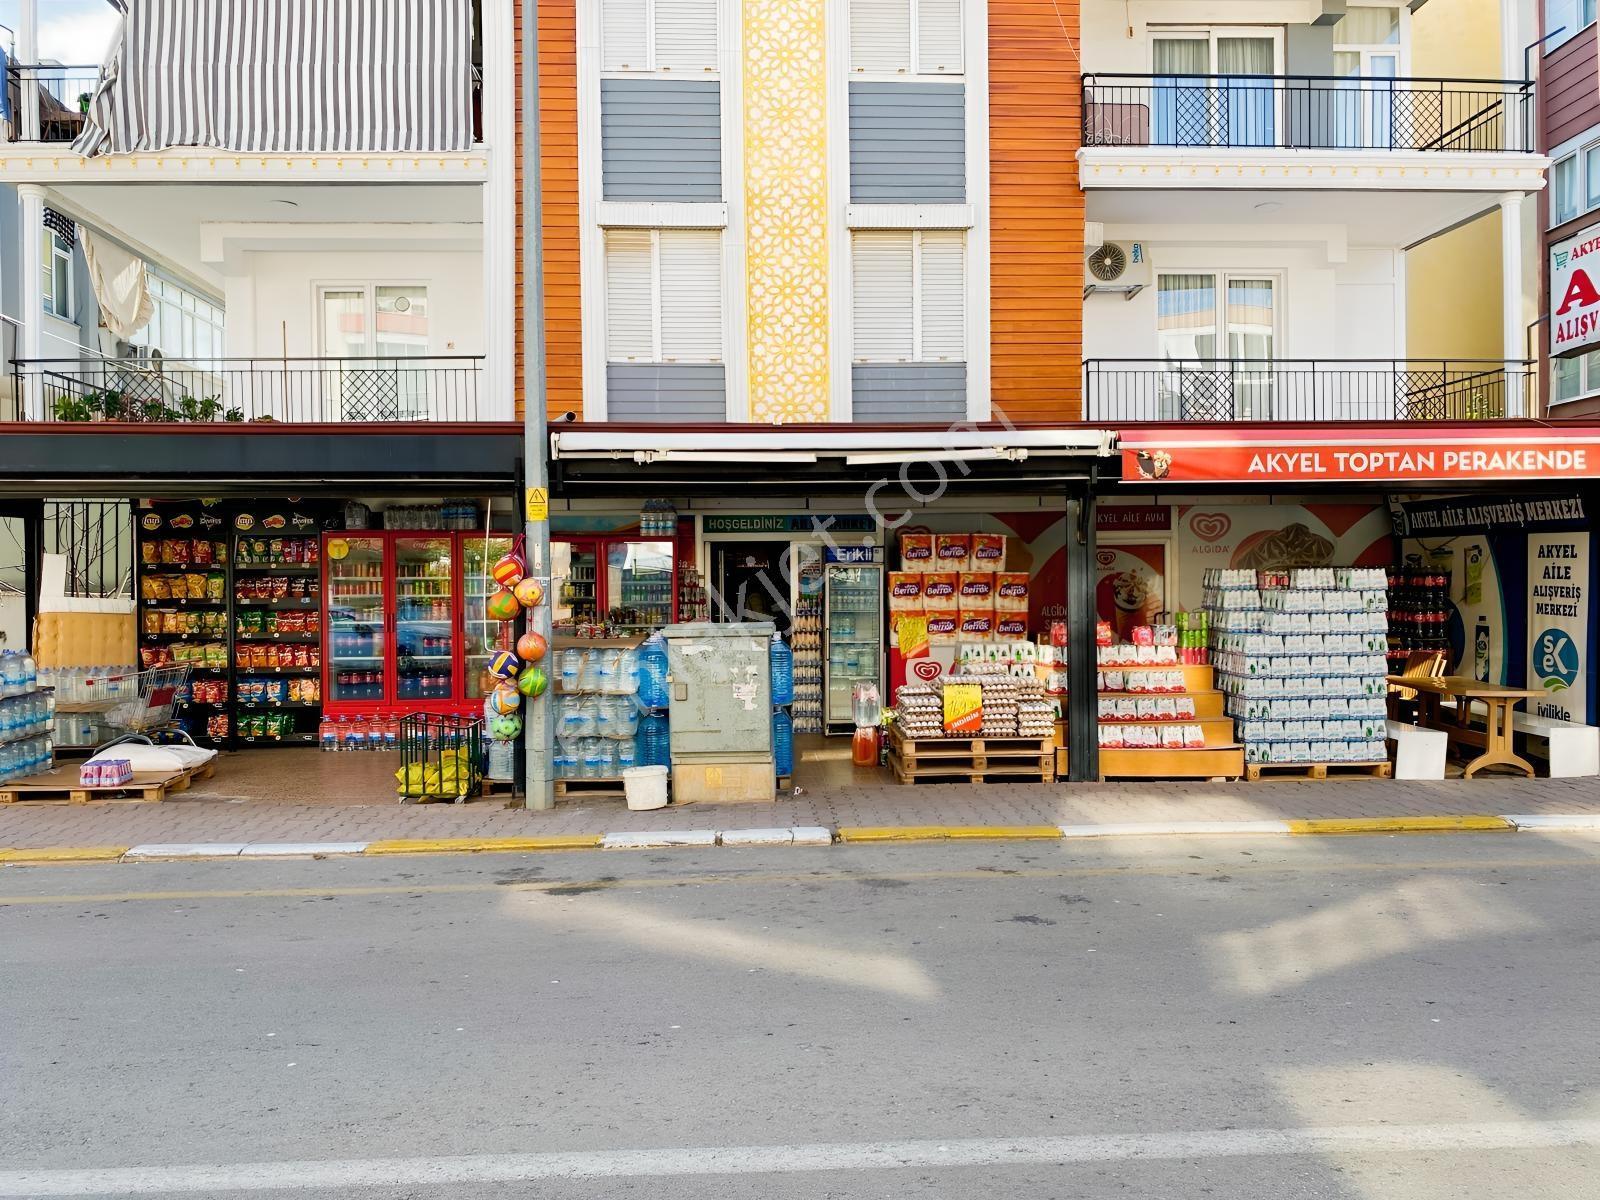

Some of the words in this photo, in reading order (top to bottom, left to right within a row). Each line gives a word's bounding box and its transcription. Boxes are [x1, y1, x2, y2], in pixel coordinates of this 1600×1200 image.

[1248, 453, 1327, 473] AKYEL
[1334, 452, 1435, 472] TOPTAN
[1444, 450, 1587, 471] PERAKENDE
[1097, 513, 1118, 523] KYEL
[1411, 510, 1442, 529] AKYEL
[1442, 505, 1466, 527] AİLE
[1466, 499, 1526, 529] ALIŞVERİŞ
[1524, 493, 1586, 522] MERKEZİ
[708, 516, 784, 532] HOŞGELDİNİZ
[836, 548, 872, 561] Erikli
[1537, 544, 1578, 559] AKYEL
[1543, 562, 1571, 580] AİLE
[894, 585, 920, 596] Berrak
[927, 586, 953, 596] Berrak
[963, 585, 989, 595] Berrak
[1533, 583, 1581, 603] ALIŞVERİŞ
[1536, 602, 1578, 618] MERKEZİ
